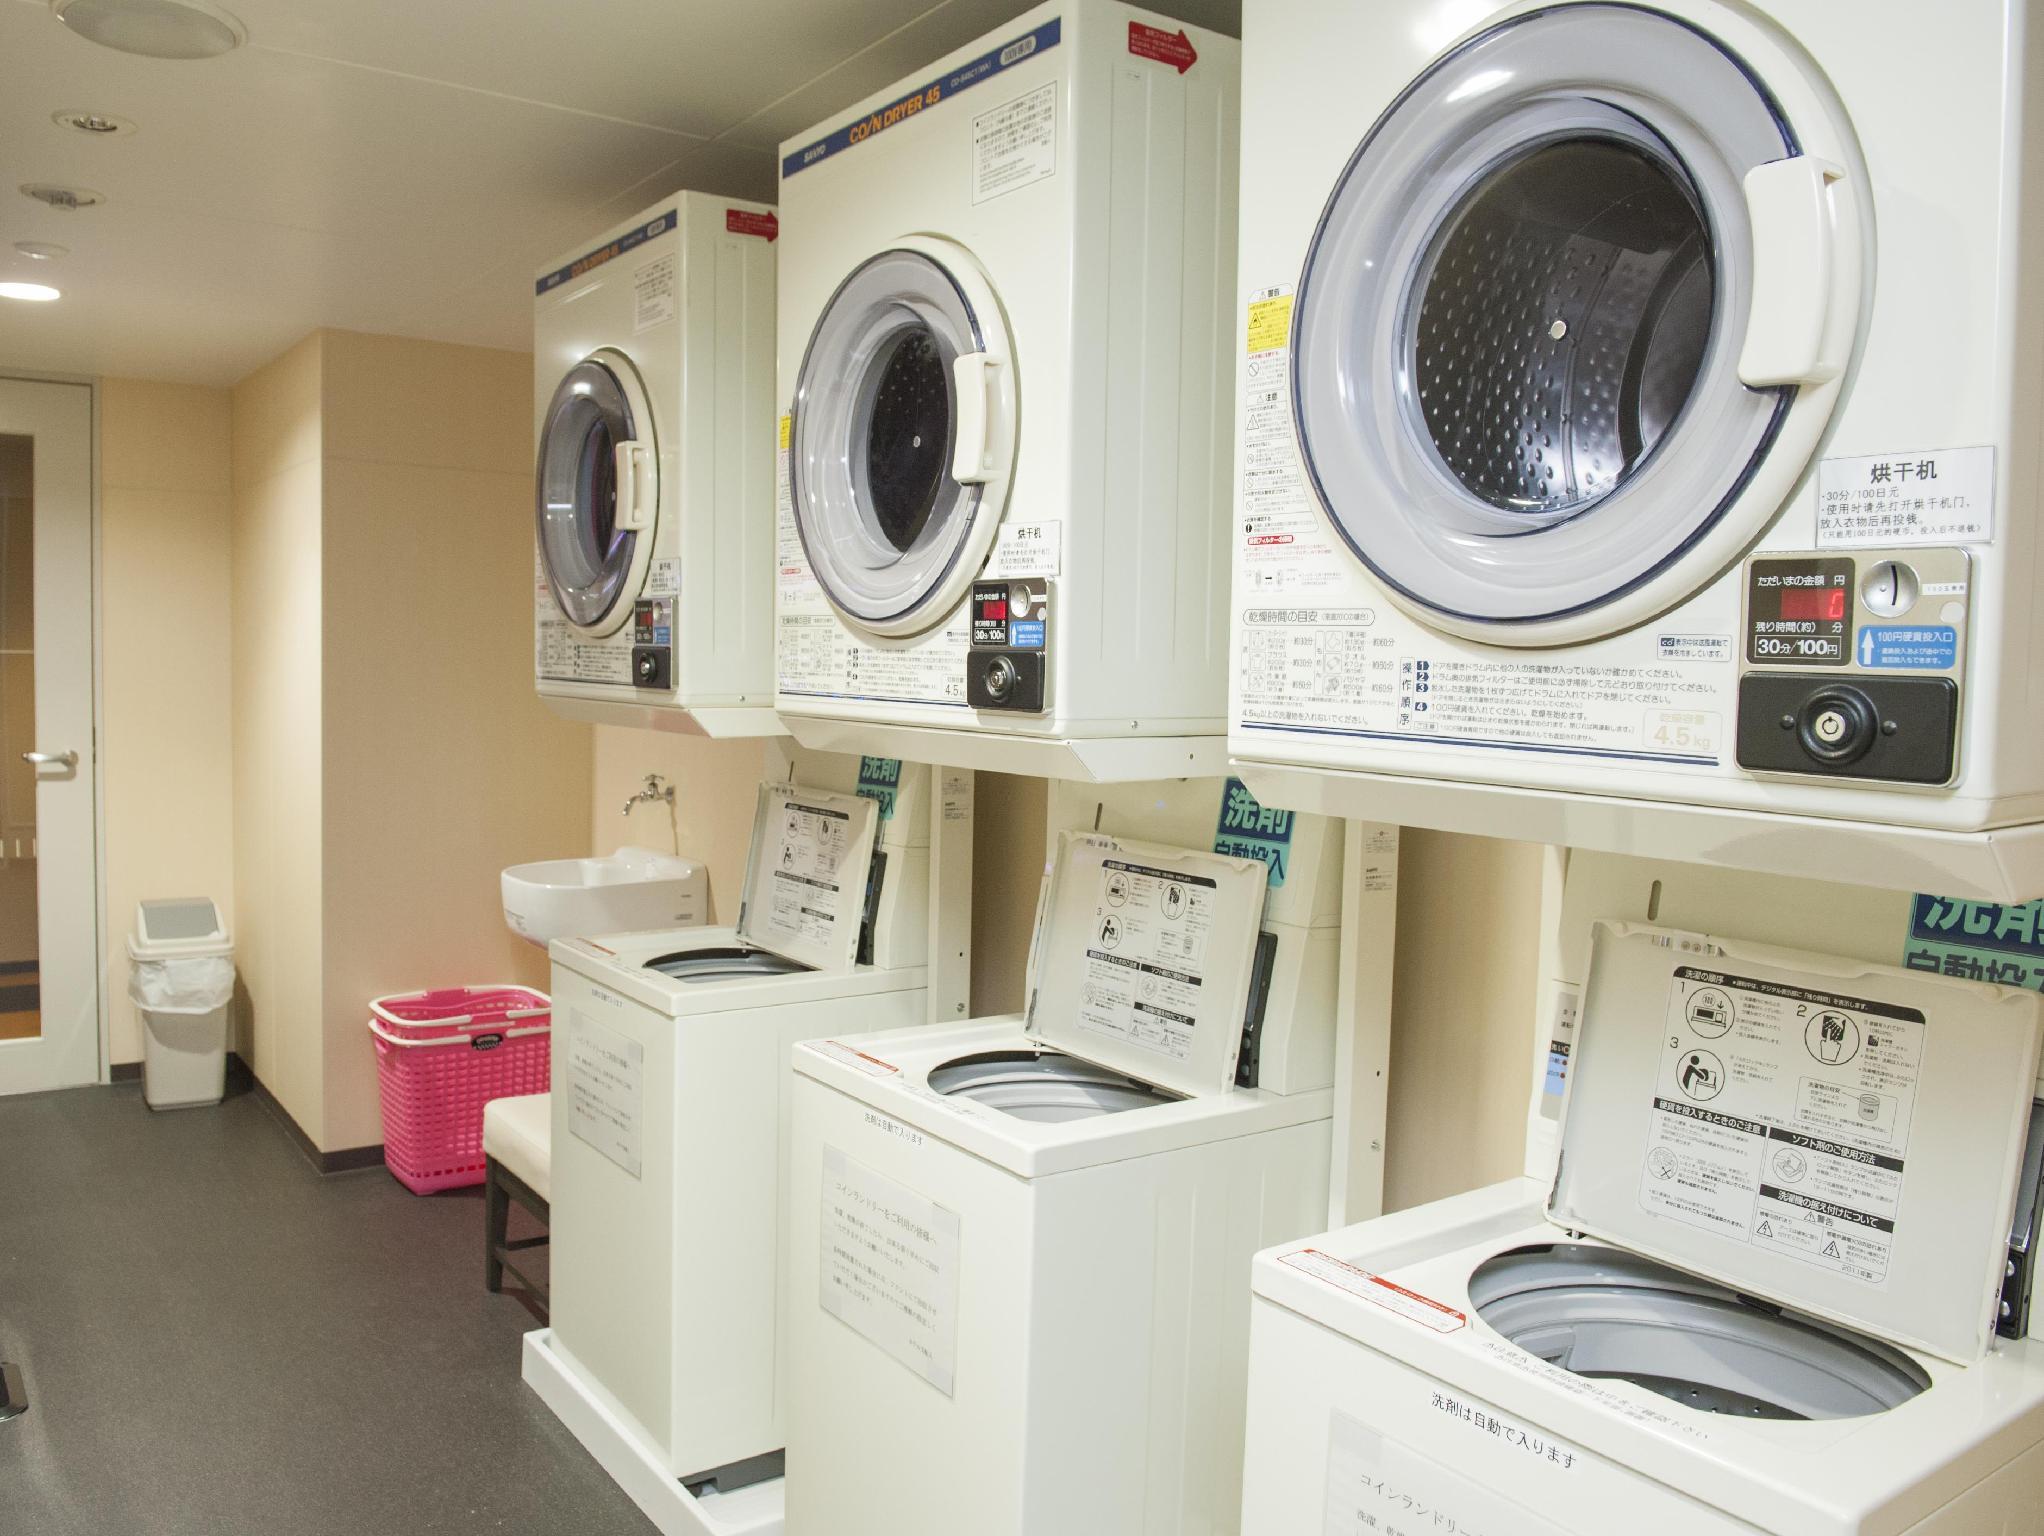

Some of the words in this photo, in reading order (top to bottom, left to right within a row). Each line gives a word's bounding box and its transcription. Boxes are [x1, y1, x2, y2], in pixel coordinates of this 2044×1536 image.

[884, 95, 923, 131] DRYER
[926, 85, 941, 106] 45
[804, 144, 826, 164] SANYO
[1870, 459, 1938, 484] 烘干机
[1757, 575, 1825, 587] ただいまの金額
[1834, 575, 1845, 586] 円
[1248, 610, 1318, 623] 乾燥時間の目安
[1755, 621, 1816, 633] 残り時間(約)
[1832, 622, 1843, 633] 分
[1877, 631, 1953, 643] 100円硬貨投入口
[1757, 638, 1838, 655] 30分/100円
[944, 683, 959, 697] 4.5
[1399, 662, 1412, 726] 操作順序
[1685, 969, 1724, 984] 洗濯の順序
[1680, 981, 1685, 993] 1
[1796, 1005, 1808, 1018] 2
[1669, 1037, 1679, 1049] 3
[1659, 1100, 1761, 1135] 硬貨を投入するときのご注意
[864, 1112, 923, 1146] 洗剤は自動で入ります
[1792, 1134, 1876, 1165] ソフト剤のご使用方法
[1777, 1190, 1879, 1228] 洗濯機の据え付けについて
[1817, 1216, 1835, 1227] 警告
[1431, 1391, 1577, 1470] 洗剤は自動で入ります
